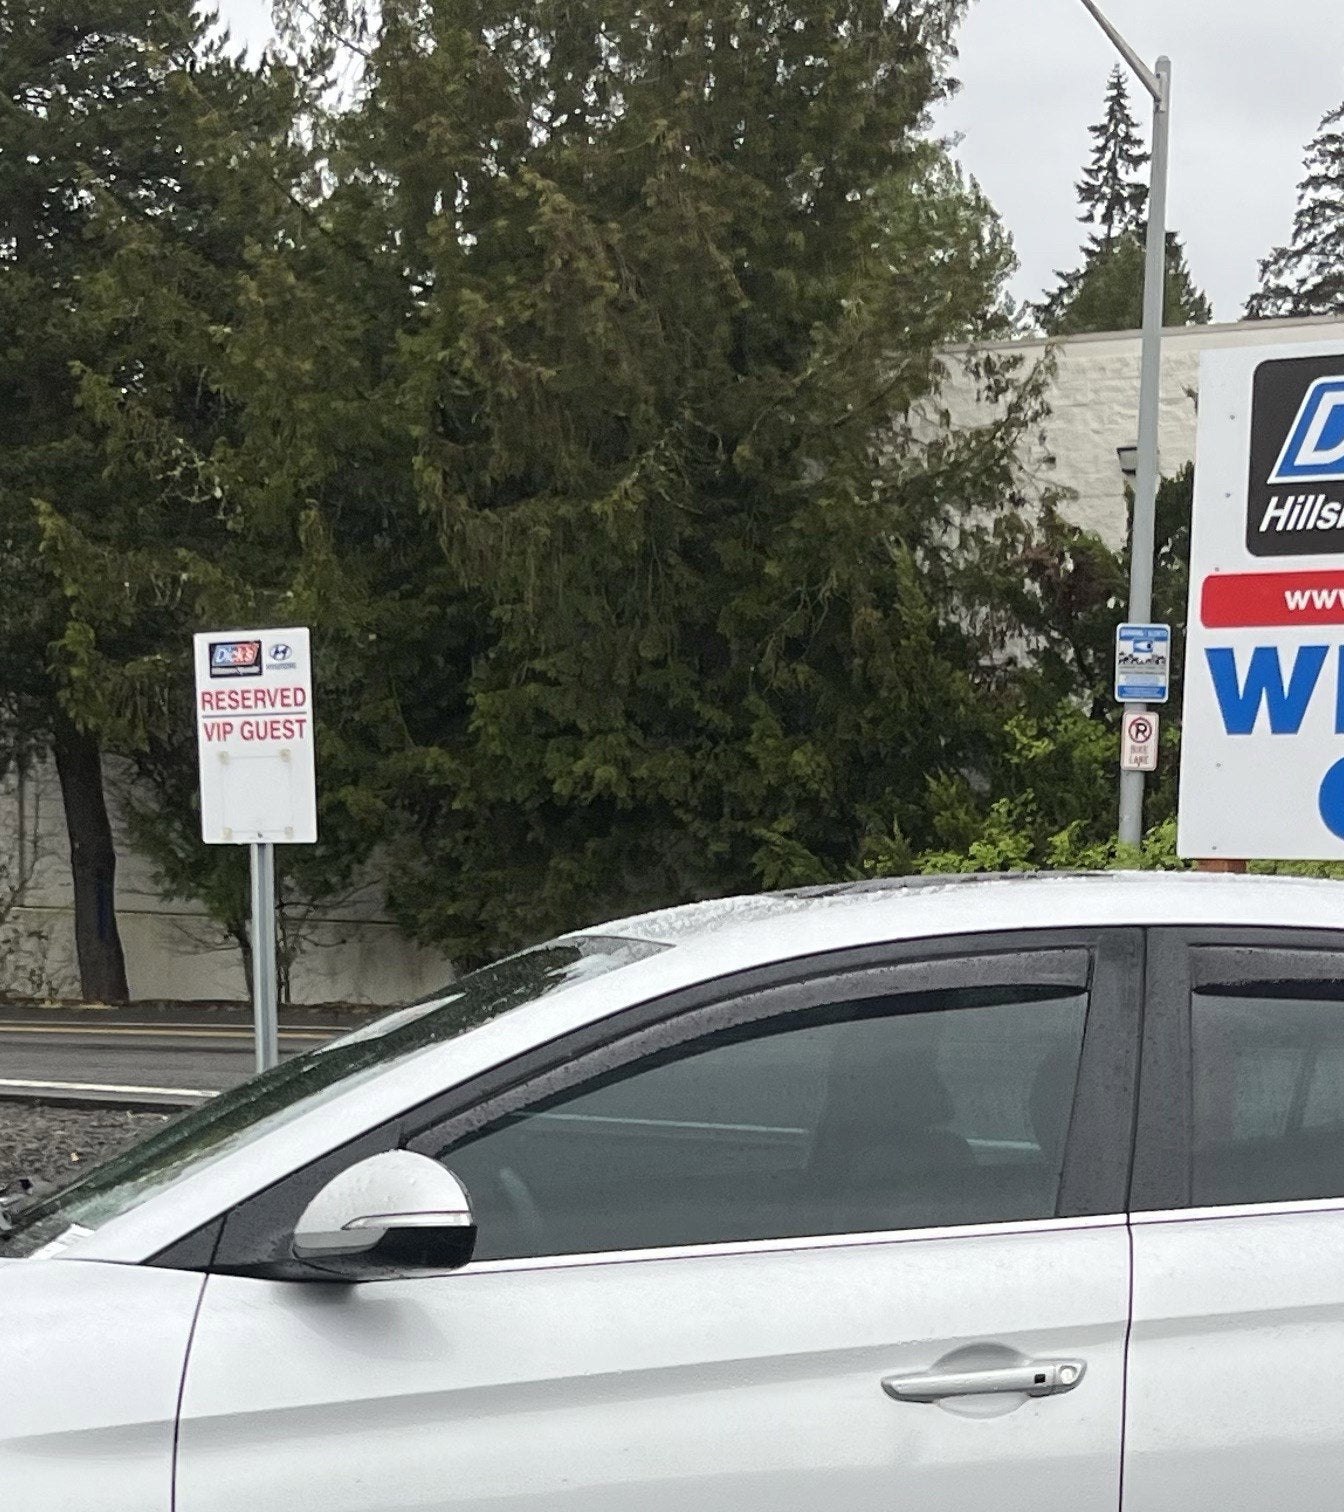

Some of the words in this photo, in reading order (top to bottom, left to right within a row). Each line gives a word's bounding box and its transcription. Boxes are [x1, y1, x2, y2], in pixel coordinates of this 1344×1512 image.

[201, 687, 307, 712] RESERVED
[204, 721, 234, 742] VIP
[240, 719, 307, 741] GUEST
